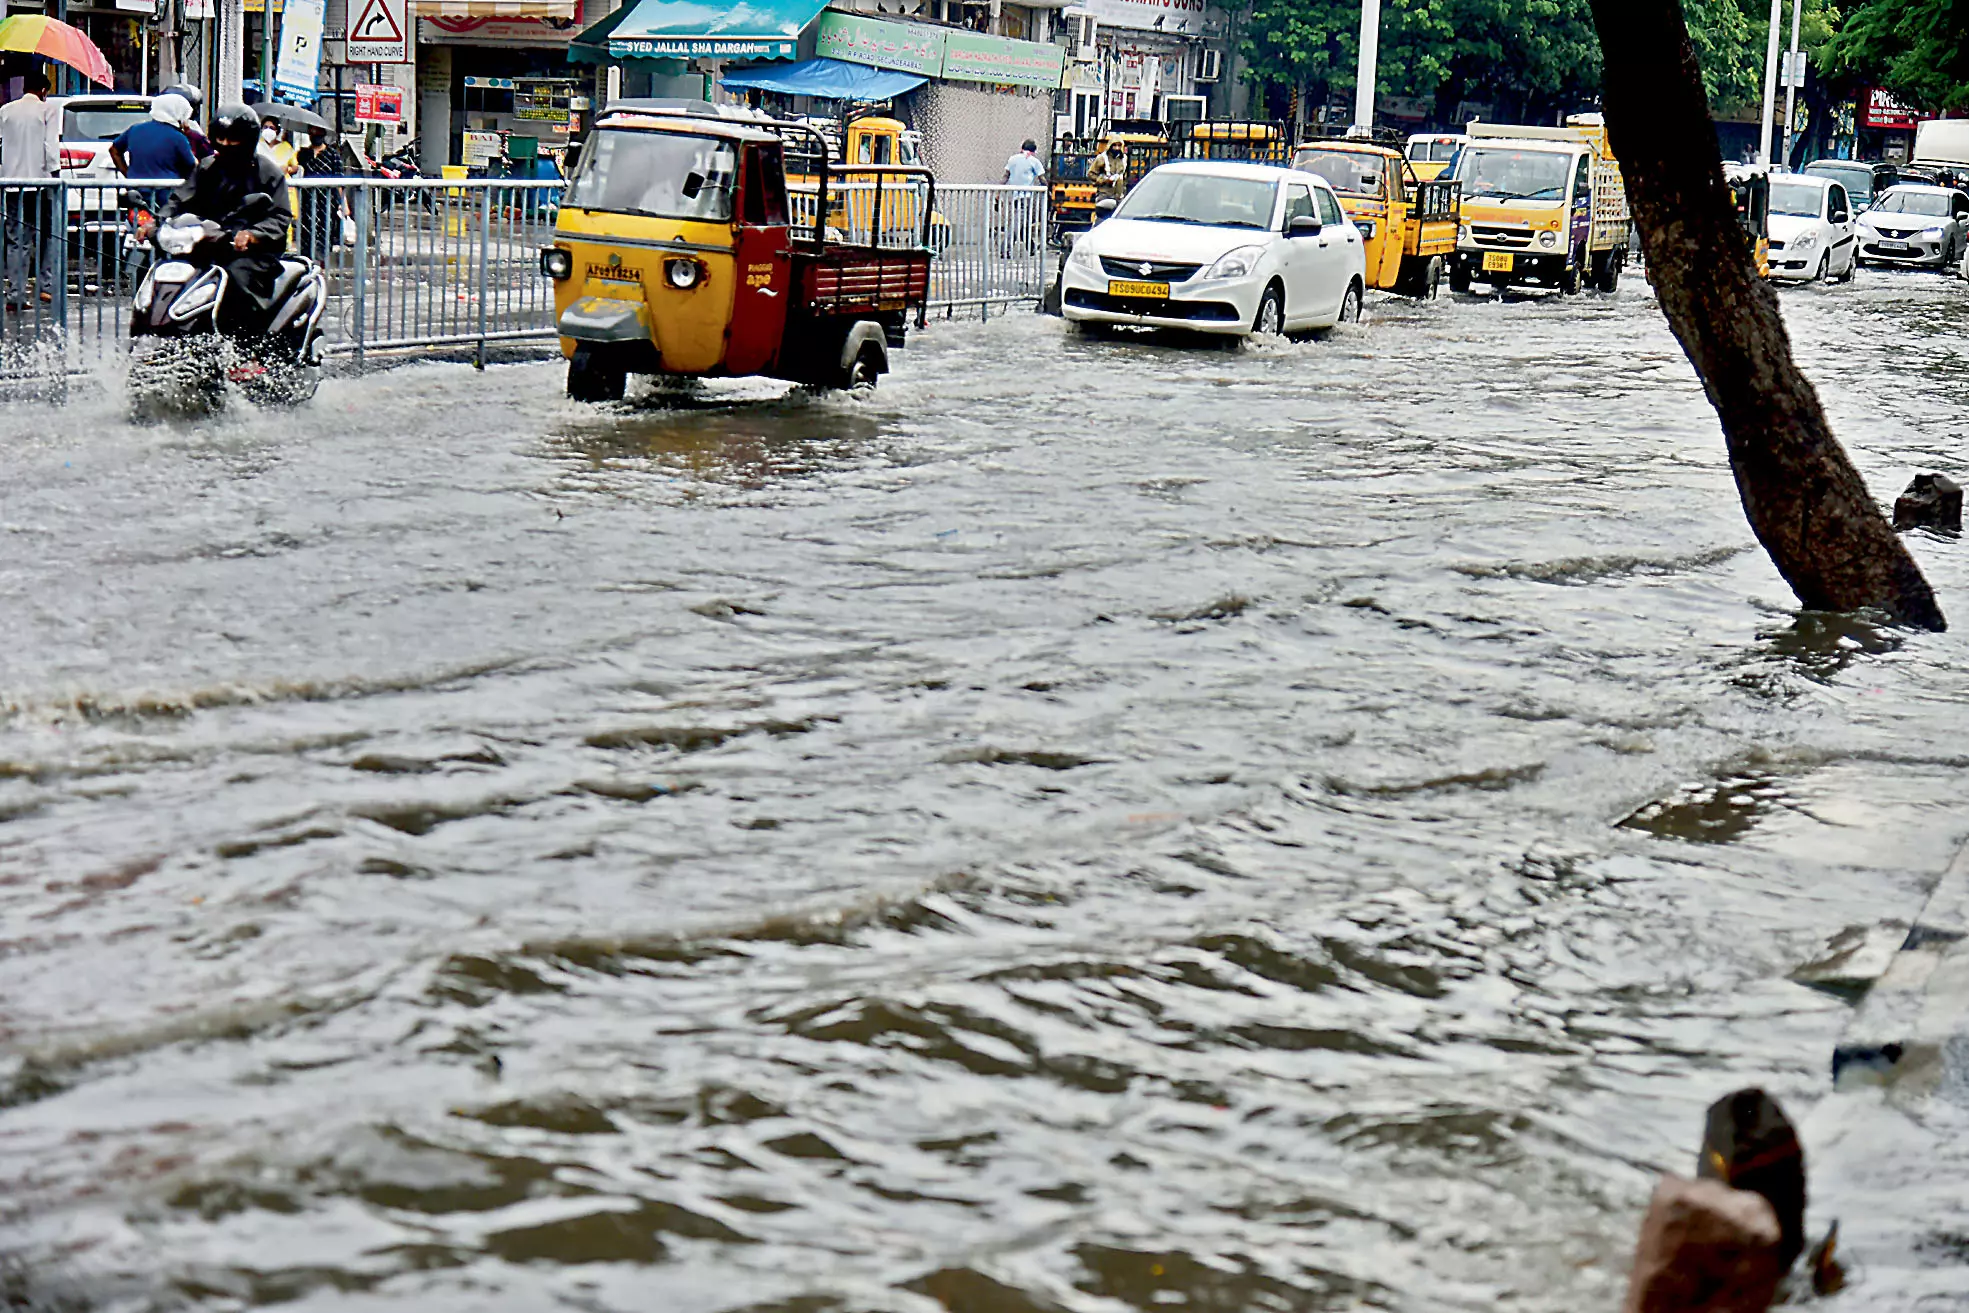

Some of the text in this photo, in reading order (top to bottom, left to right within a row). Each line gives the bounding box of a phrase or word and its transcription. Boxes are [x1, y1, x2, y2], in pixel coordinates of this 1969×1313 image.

[350, 46, 403, 56] RIGHT HAND CURVE
[627, 41, 652, 53] SYED
[654, 42, 690, 53] JALLAL
[691, 42, 712, 54] SHA
[714, 43, 754, 54] DARGAH
[877, 54, 922, 70] SECUNDERABAD
[746, 274, 771, 288] ape
